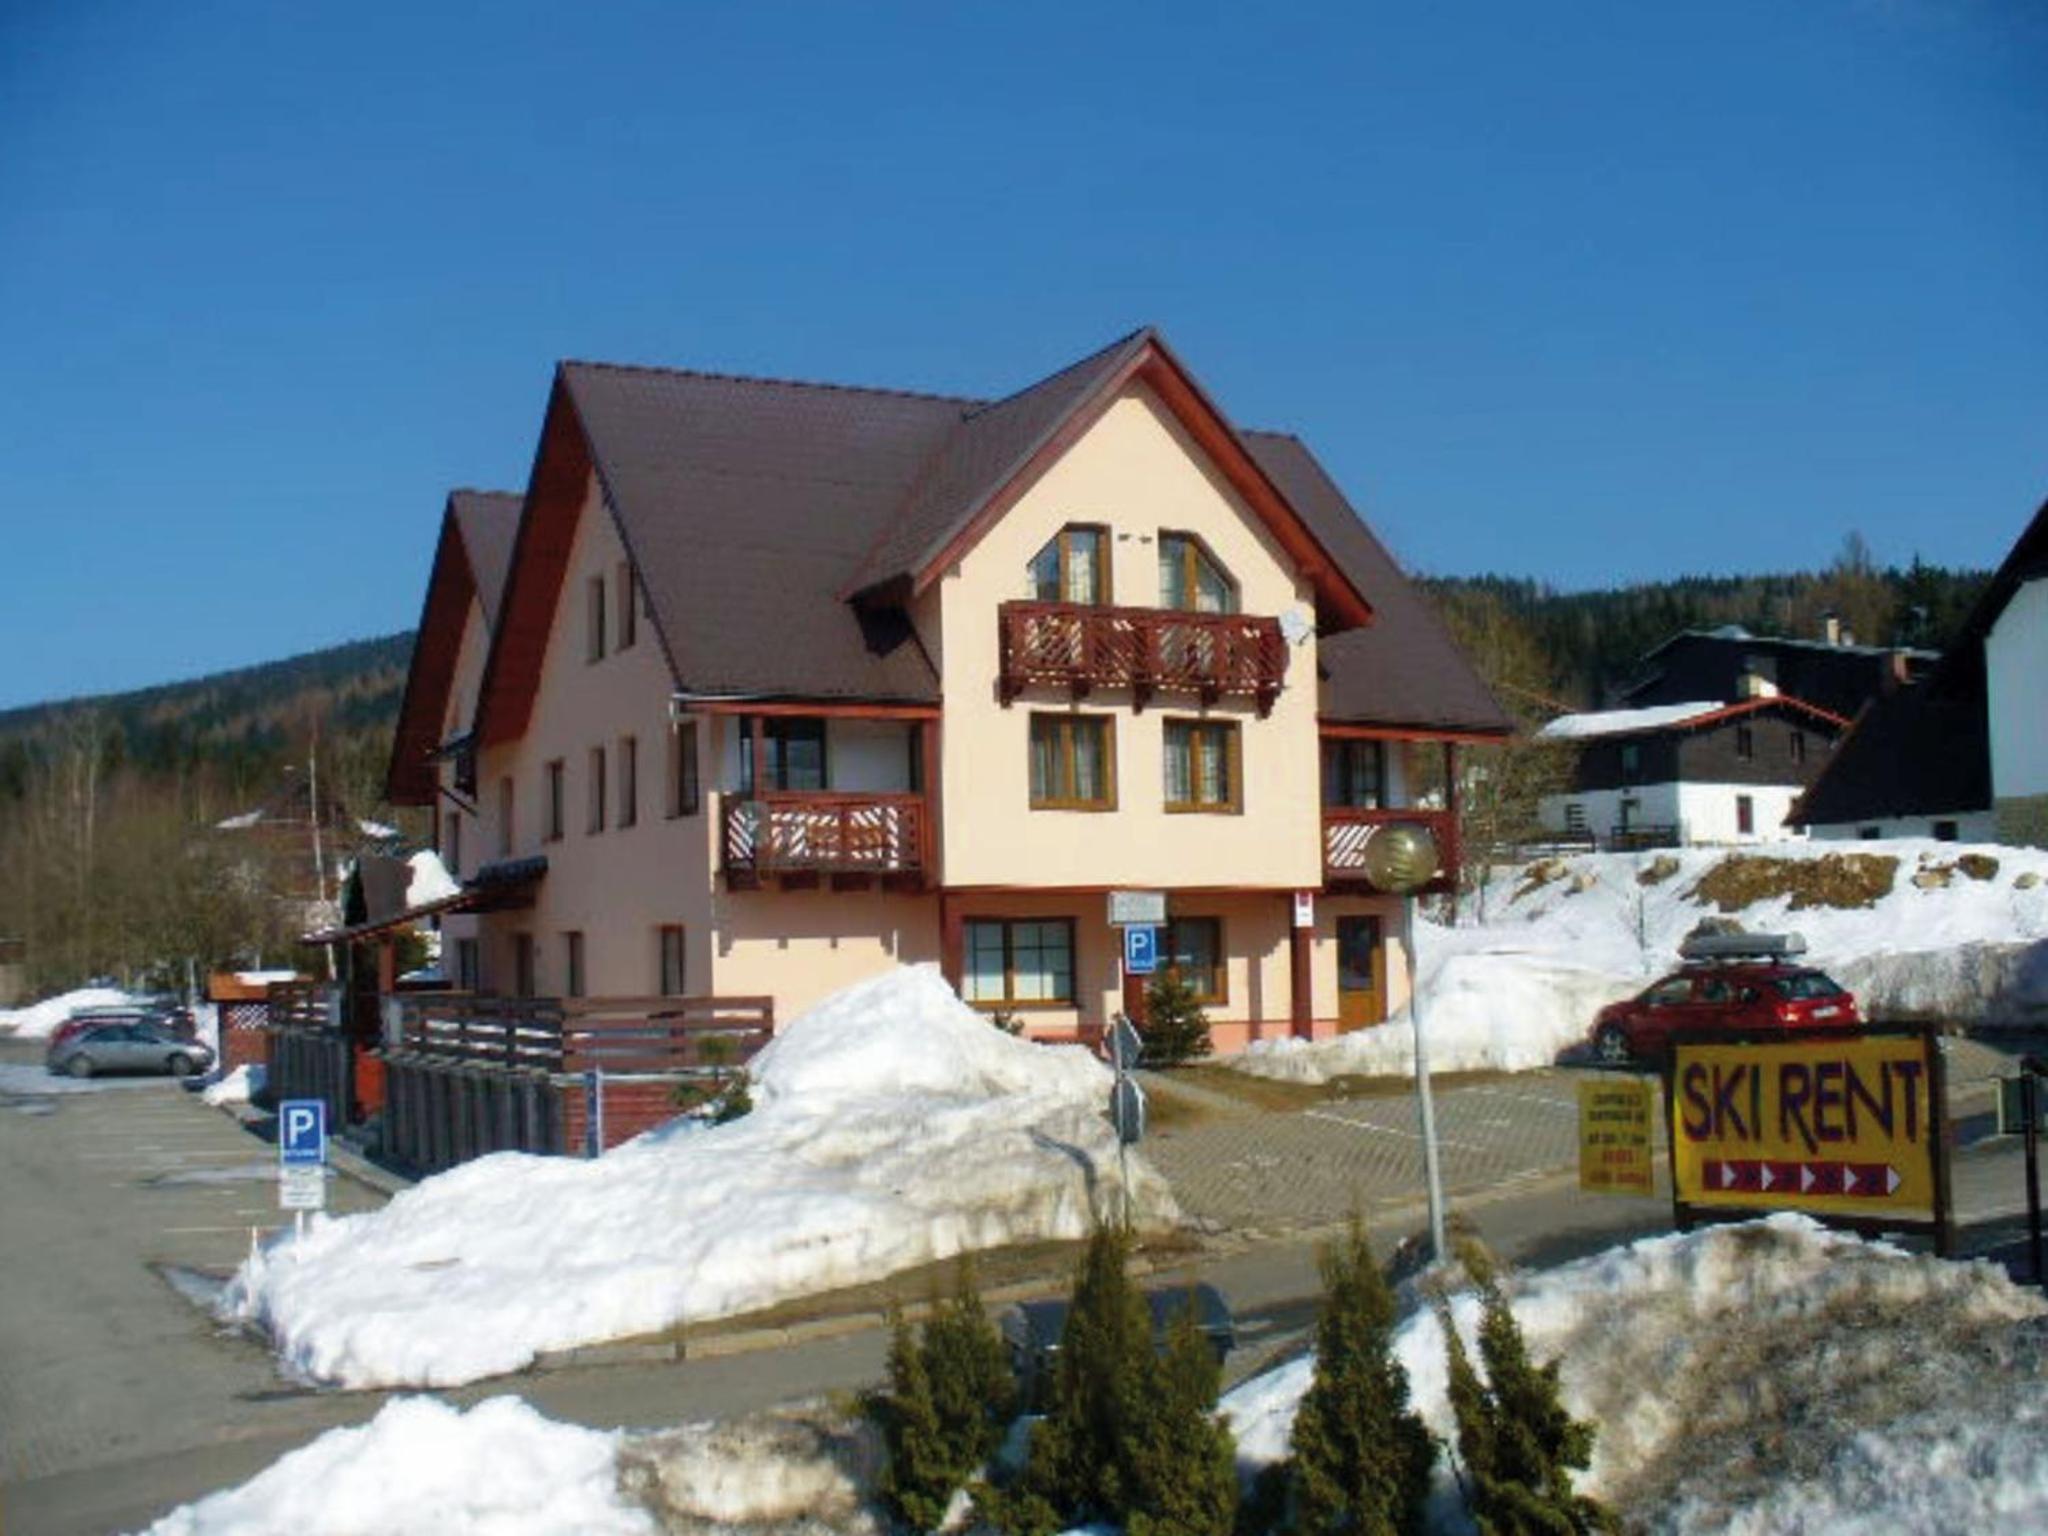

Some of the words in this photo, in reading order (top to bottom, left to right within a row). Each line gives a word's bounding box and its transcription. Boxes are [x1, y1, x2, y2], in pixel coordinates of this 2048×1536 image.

[1130, 932, 1149, 958] P
[1682, 1062, 1761, 1142] SKI
[1778, 1059, 1923, 1154] RENT
[289, 1108, 315, 1147] P
